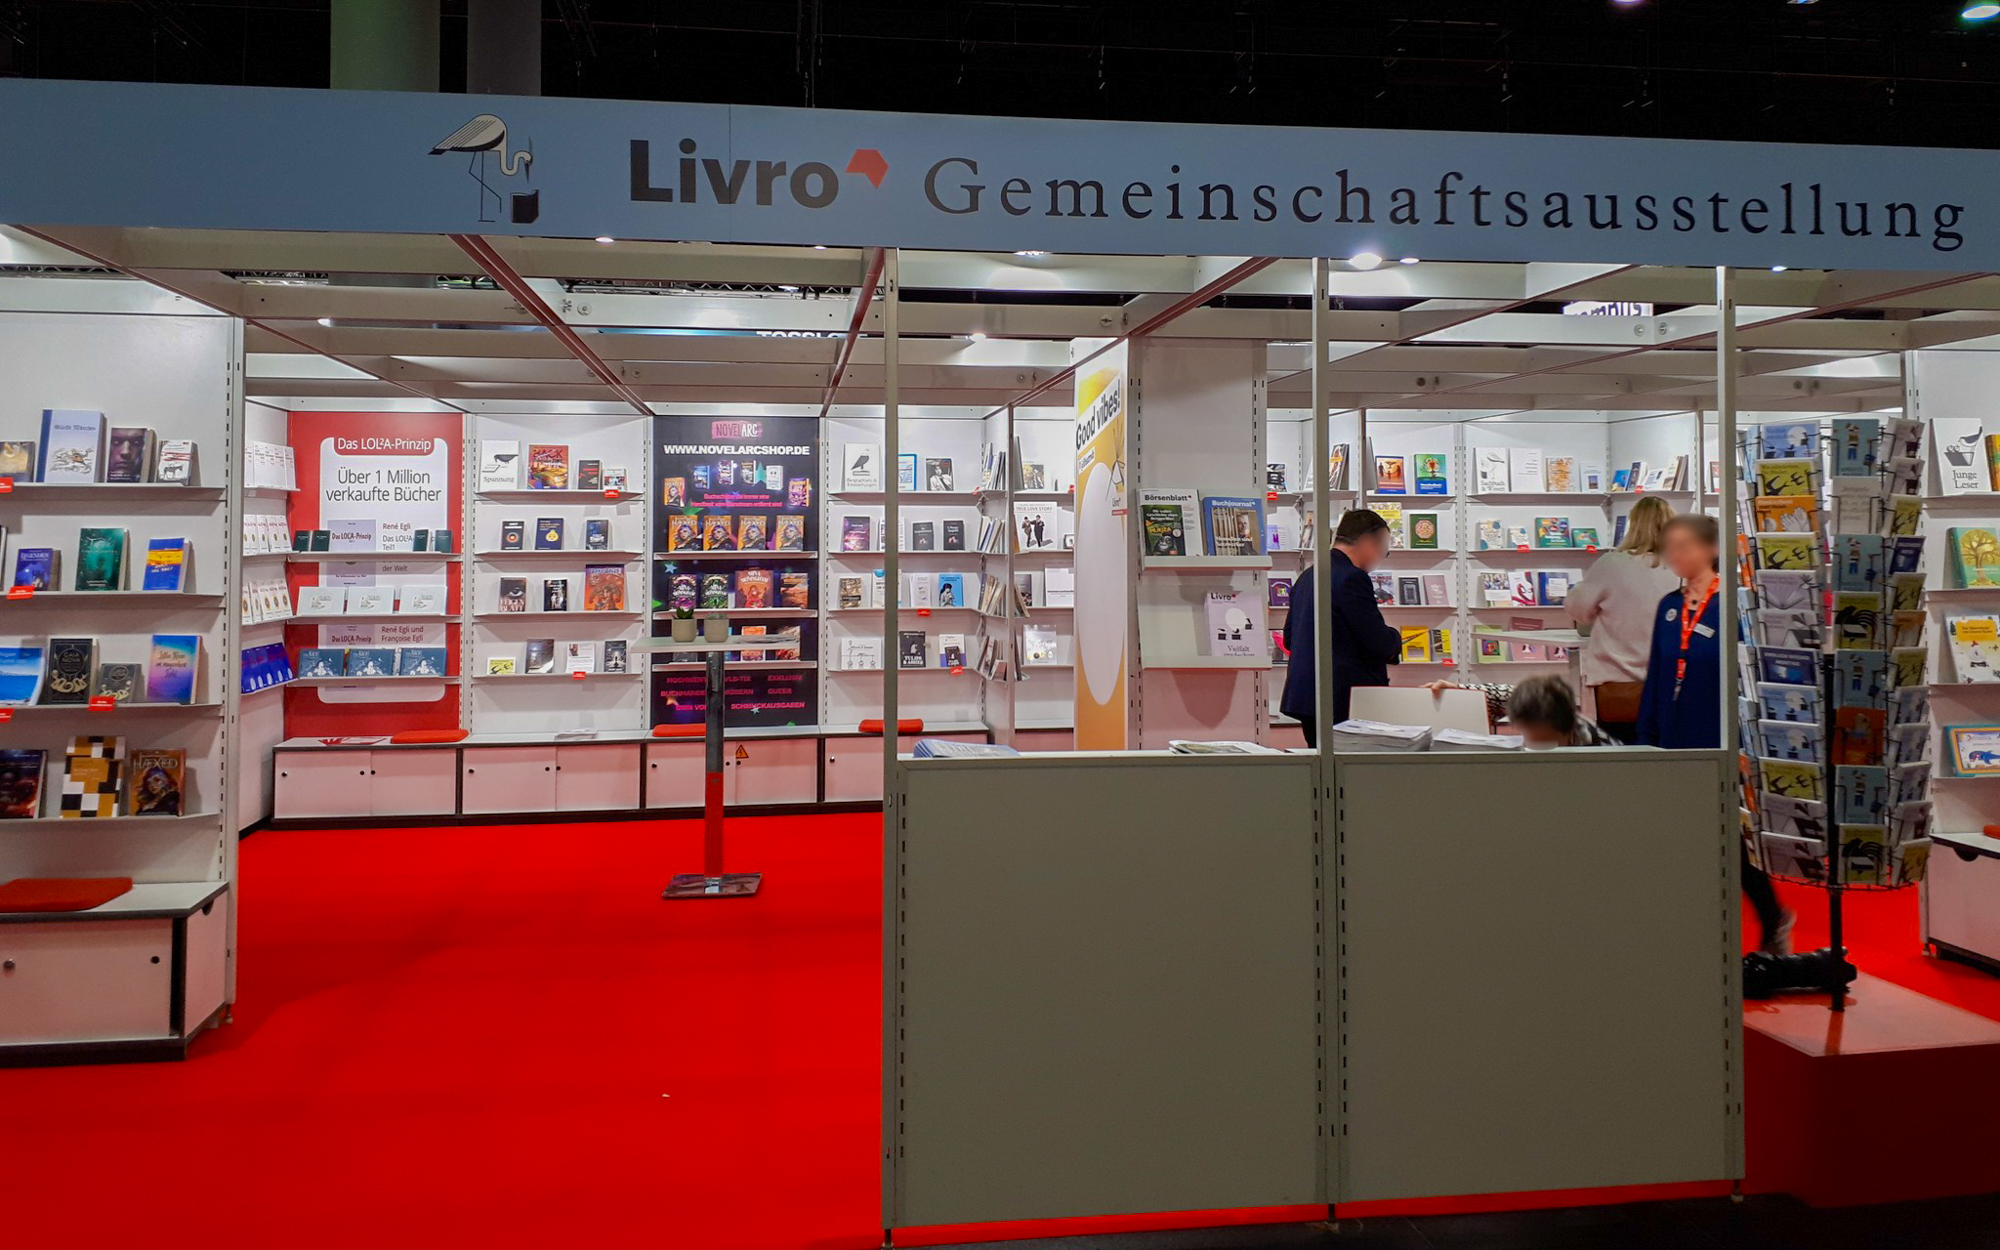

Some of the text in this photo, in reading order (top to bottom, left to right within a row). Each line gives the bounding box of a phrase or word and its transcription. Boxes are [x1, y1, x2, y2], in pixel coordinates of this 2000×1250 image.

[630, 138, 1966, 251] Livro Gemeinschaftsausstellung
[1076, 405, 1096, 450] Good
[1097, 379, 1120, 429] vibes!
[338, 438, 358, 450] Das
[664, 445, 810, 456] WWW.NOVELARCSHOP.DE
[338, 466, 430, 484] Über 1 Million
[483, 475, 515, 484] Spannung
[1952, 470, 1978, 481] Junge
[1954, 480, 1978, 489] Leser
[326, 486, 442, 501] verkaufte Bücher
[1211, 500, 1252, 508] Buchjournal
[382, 522, 411, 531] René Egli
[382, 535, 394, 543] Das
[382, 564, 408, 572] der Welt
[1210, 592, 1232, 601] Livro
[382, 625, 424, 634] René Egli und
[381, 635, 423, 643] Françoise Egli
[1227, 644, 1250, 652] Vielfalt
